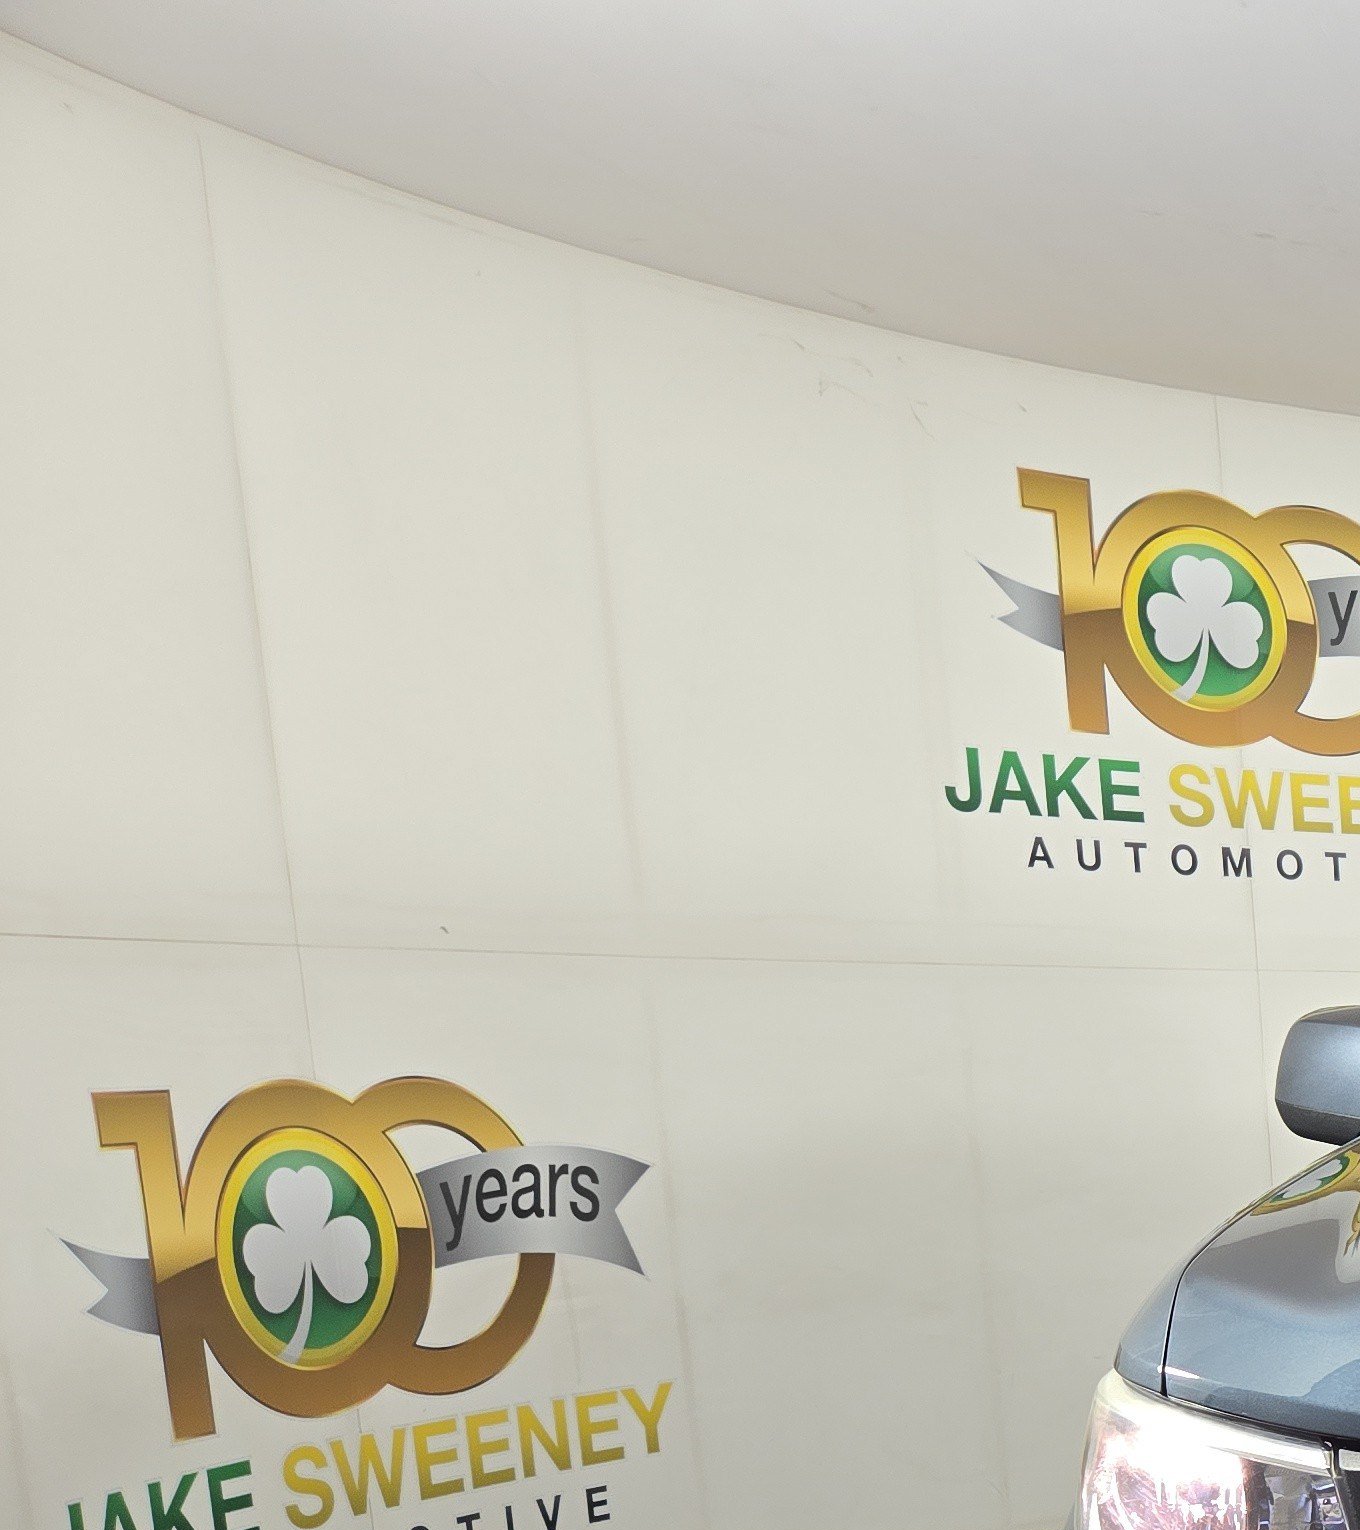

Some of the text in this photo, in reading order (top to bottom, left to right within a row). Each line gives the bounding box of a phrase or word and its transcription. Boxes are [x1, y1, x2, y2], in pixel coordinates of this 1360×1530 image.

[944, 746, 1145, 824] JAKE
[90, 1075, 601, 1444] 100 years
[282, 1381, 674, 1530] SWEENEY
